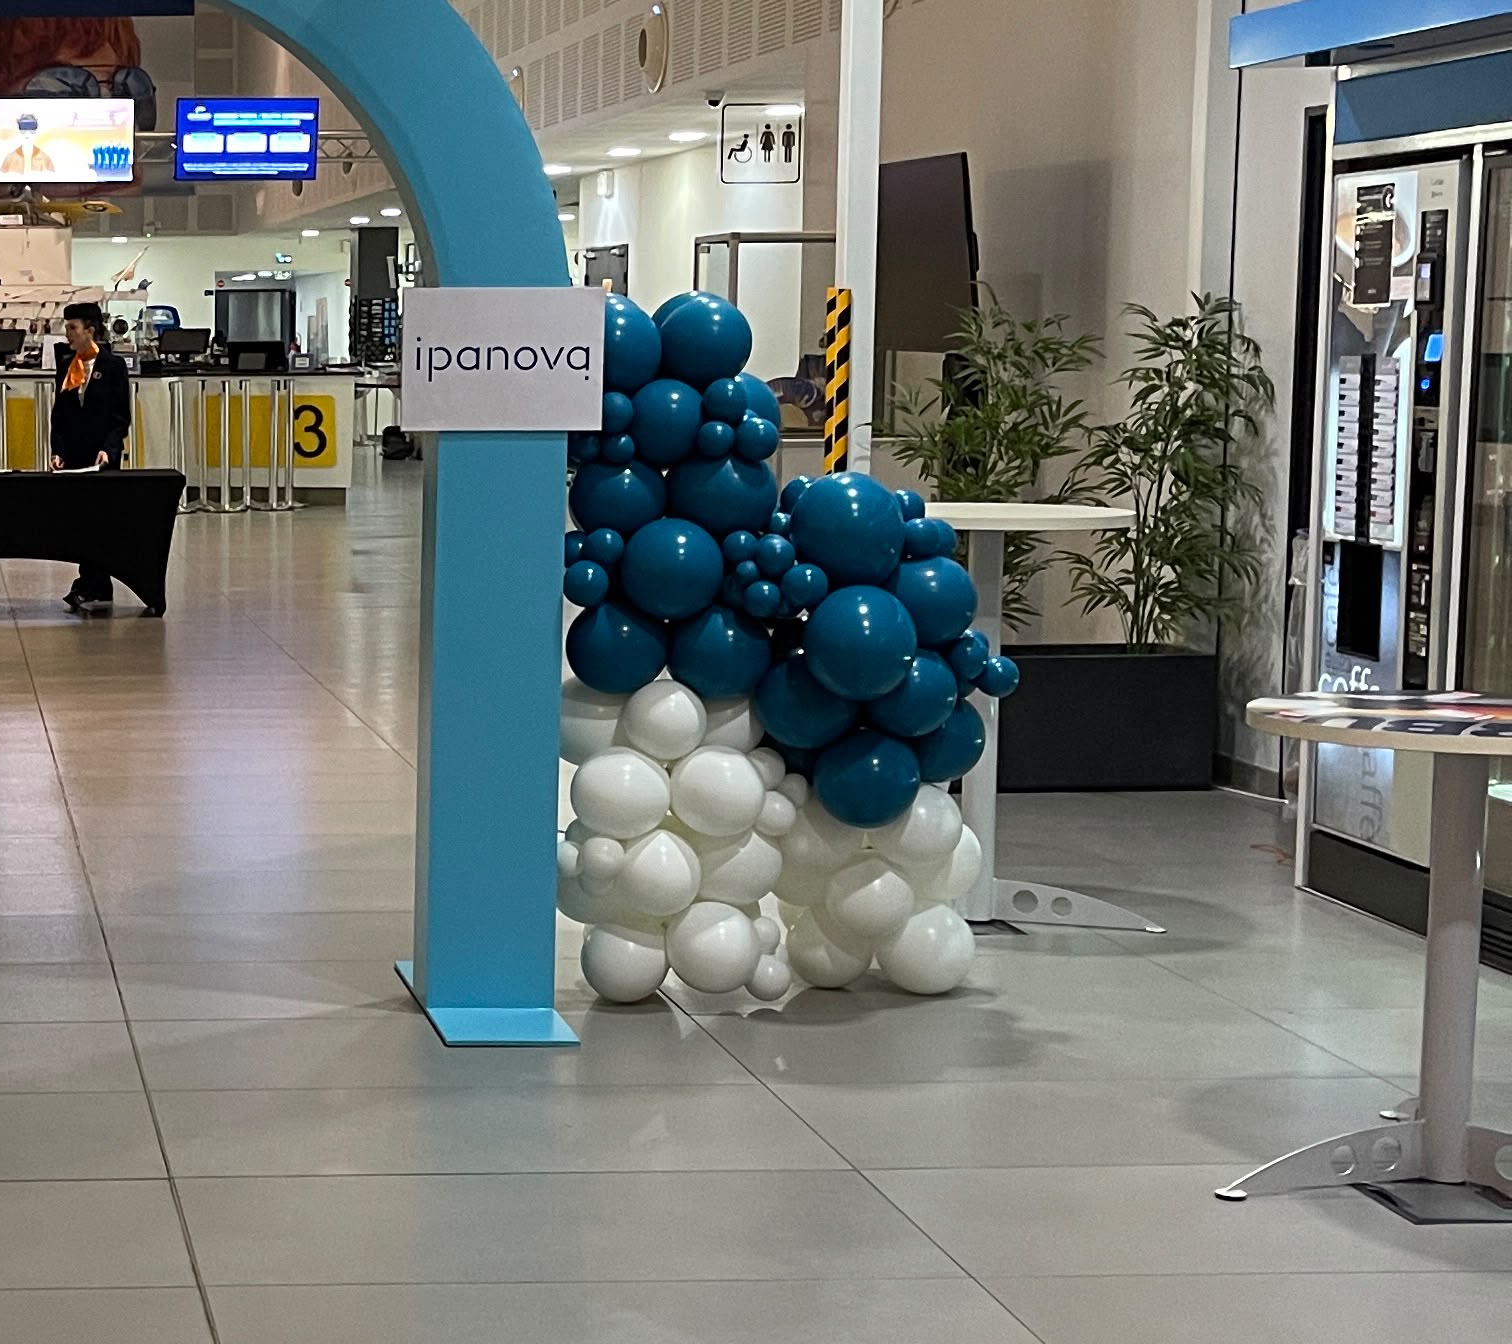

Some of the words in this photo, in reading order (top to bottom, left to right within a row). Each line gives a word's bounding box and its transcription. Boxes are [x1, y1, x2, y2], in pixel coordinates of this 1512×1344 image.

[416, 337, 590, 382] ipanova
[293, 404, 328, 458] 3
[1318, 665, 1380, 692] coff
